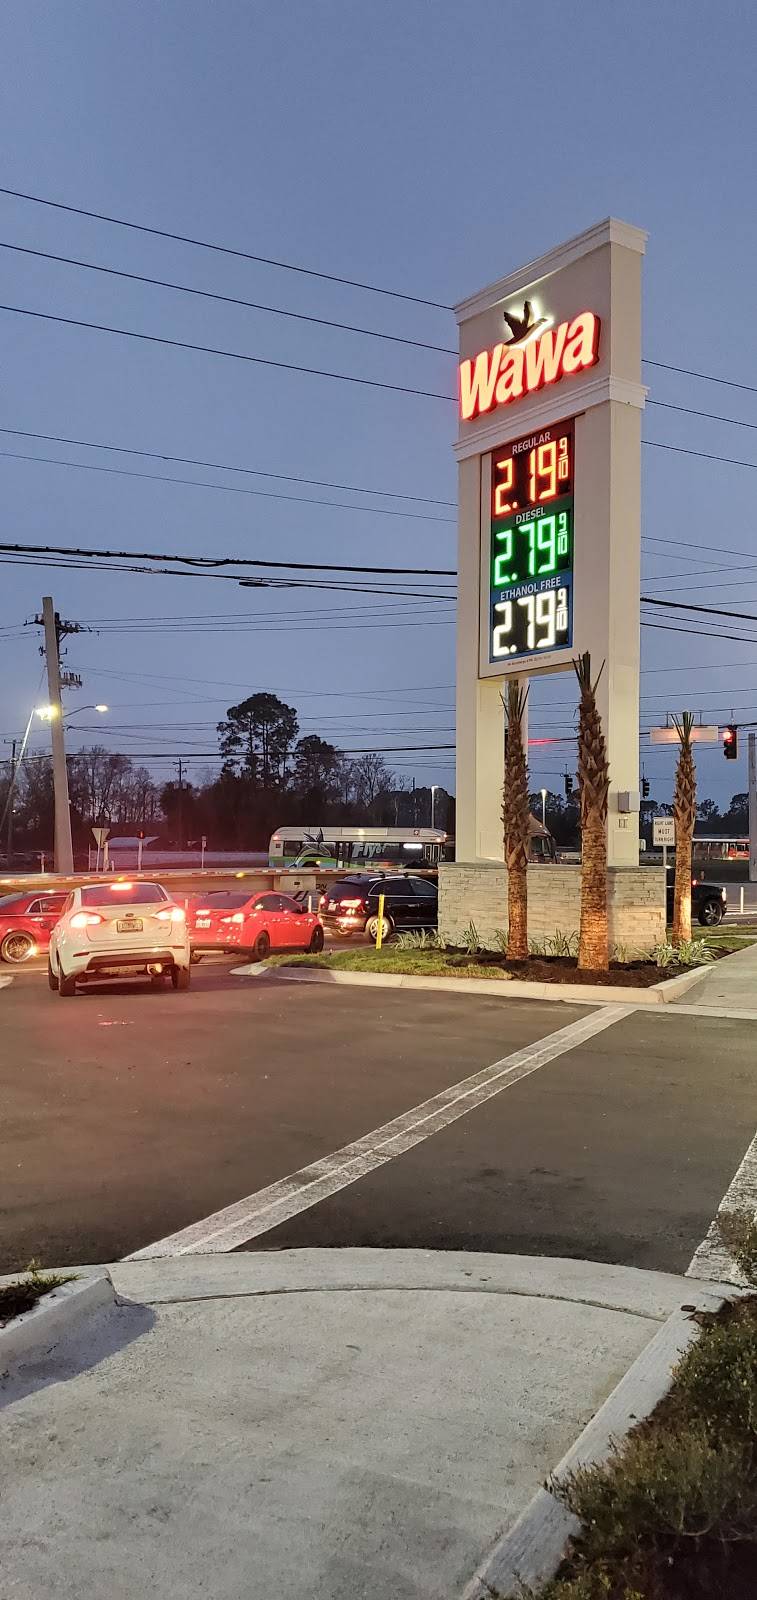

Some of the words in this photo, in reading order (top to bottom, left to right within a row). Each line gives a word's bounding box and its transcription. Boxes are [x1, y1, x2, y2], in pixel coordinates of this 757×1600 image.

[460, 311, 600, 420] Wawa
[512, 431, 551, 454] REGULAR
[495, 441, 557, 515] 2.19
[516, 507, 546, 524] DIESEL
[494, 515, 556, 586] 2.79
[500, 583, 539, 600] ETHANOL
[540, 576, 561, 594] FREE
[493, 590, 556, 656] 2.79
